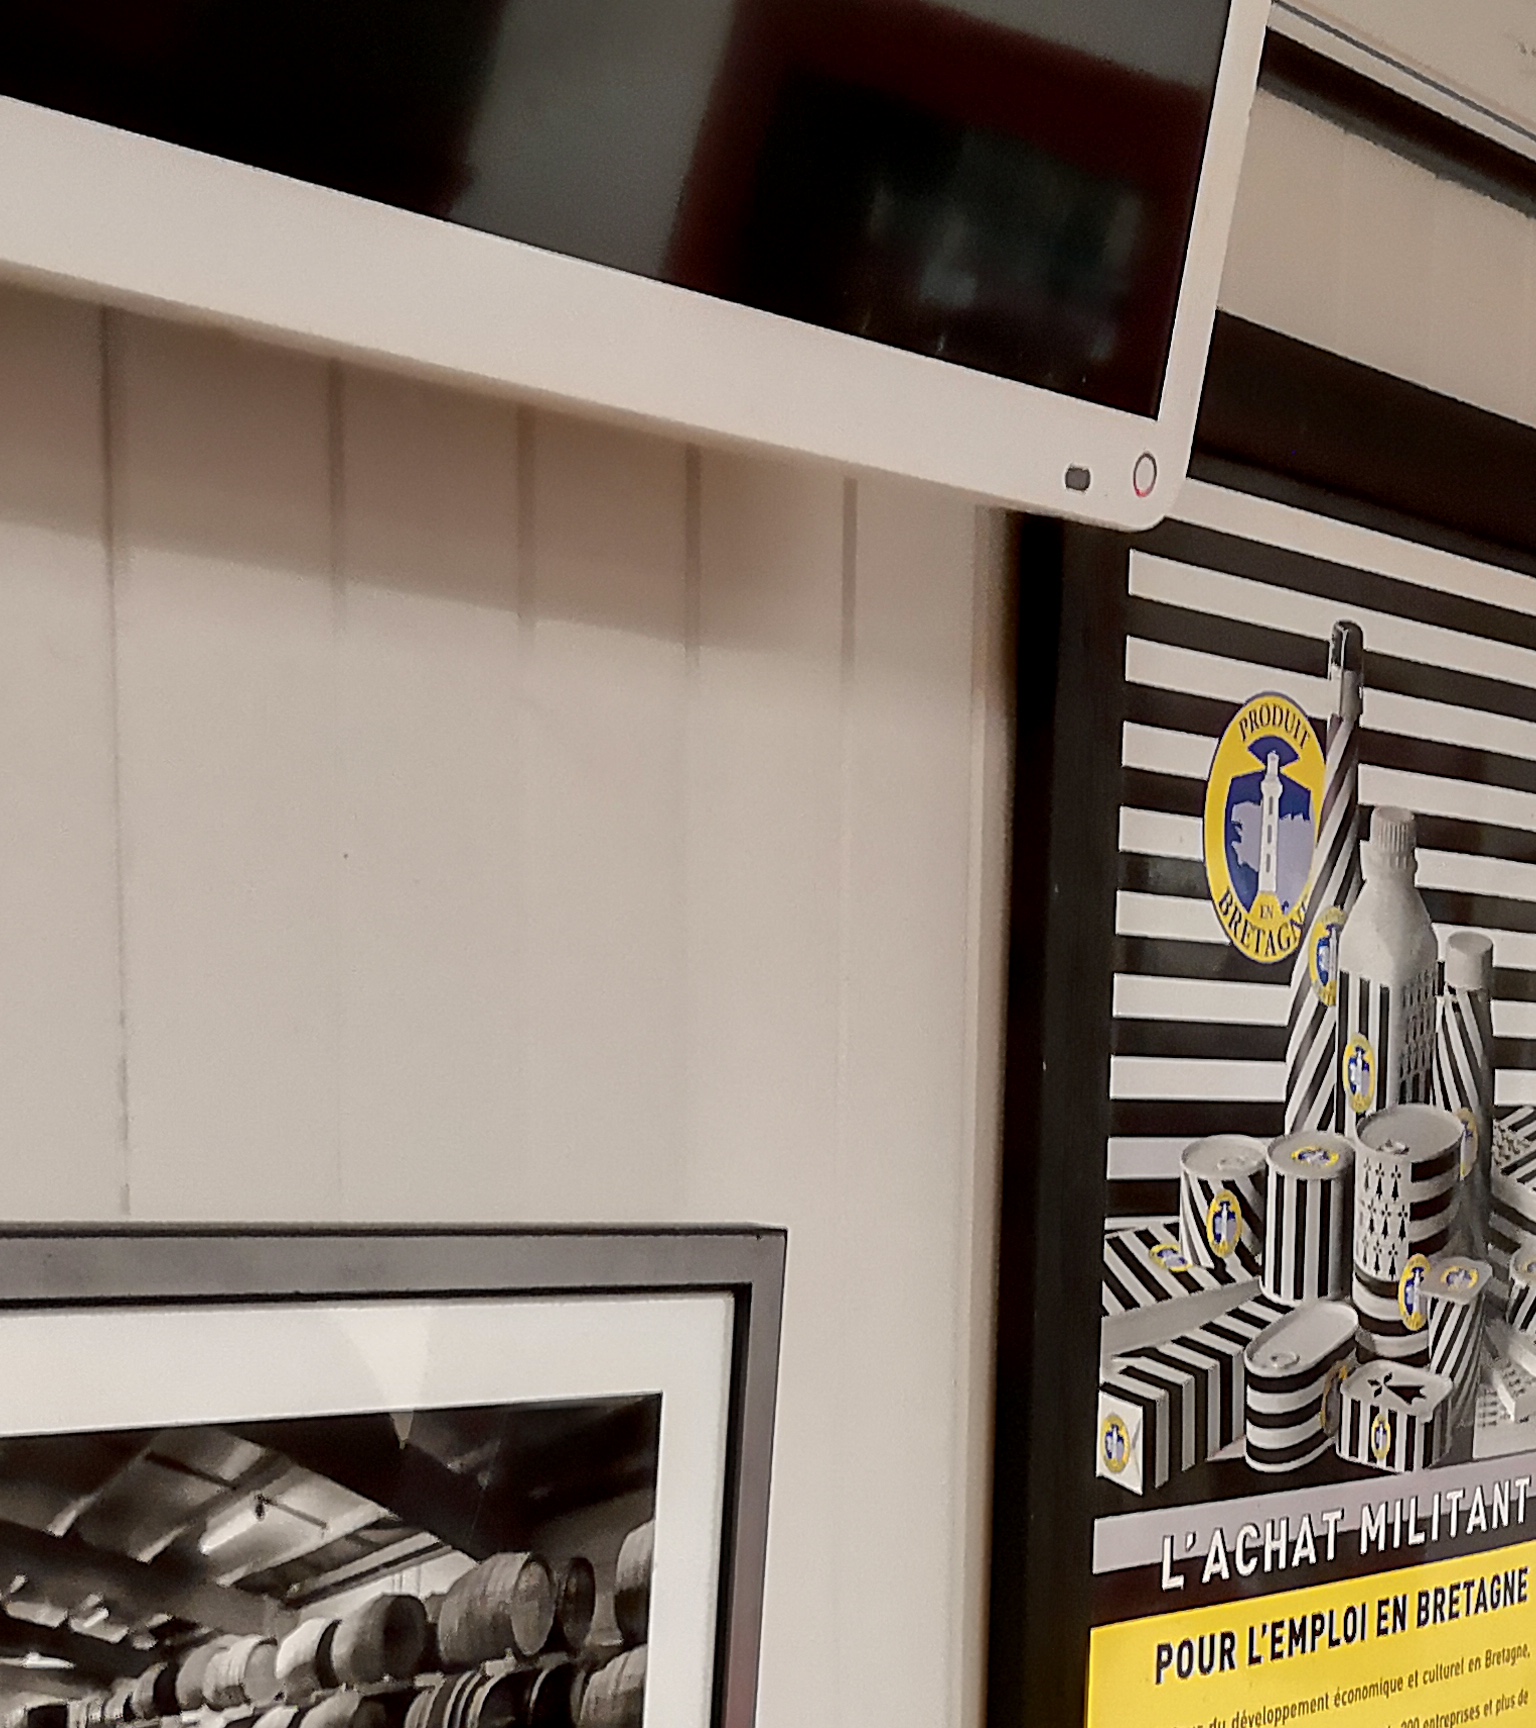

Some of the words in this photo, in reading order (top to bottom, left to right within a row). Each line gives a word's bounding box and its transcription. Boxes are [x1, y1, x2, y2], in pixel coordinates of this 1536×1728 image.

[1238, 703, 1311, 750] PRODUIT
[1260, 904, 1274, 919] EN
[1160, 1507, 1344, 1592] L'ACHAT
[1360, 1475, 1532, 1556] MILITANT
[1155, 1631, 1236, 1685] POUR
[1248, 1602, 1367, 1666] L'EMPLOI
[1377, 1593, 1407, 1637] EN
[1417, 1566, 1529, 1629] BRETAGNE
[1334, 1677, 1404, 1709] économique
[1408, 1670, 1419, 1689] et
[1422, 1657, 1465, 1686] culturel
[1468, 1658, 1481, 1674] en
[1483, 1699, 1493, 1717] et
[1495, 1693, 1515, 1716] plus
[1517, 1688, 1529, 1706] de
